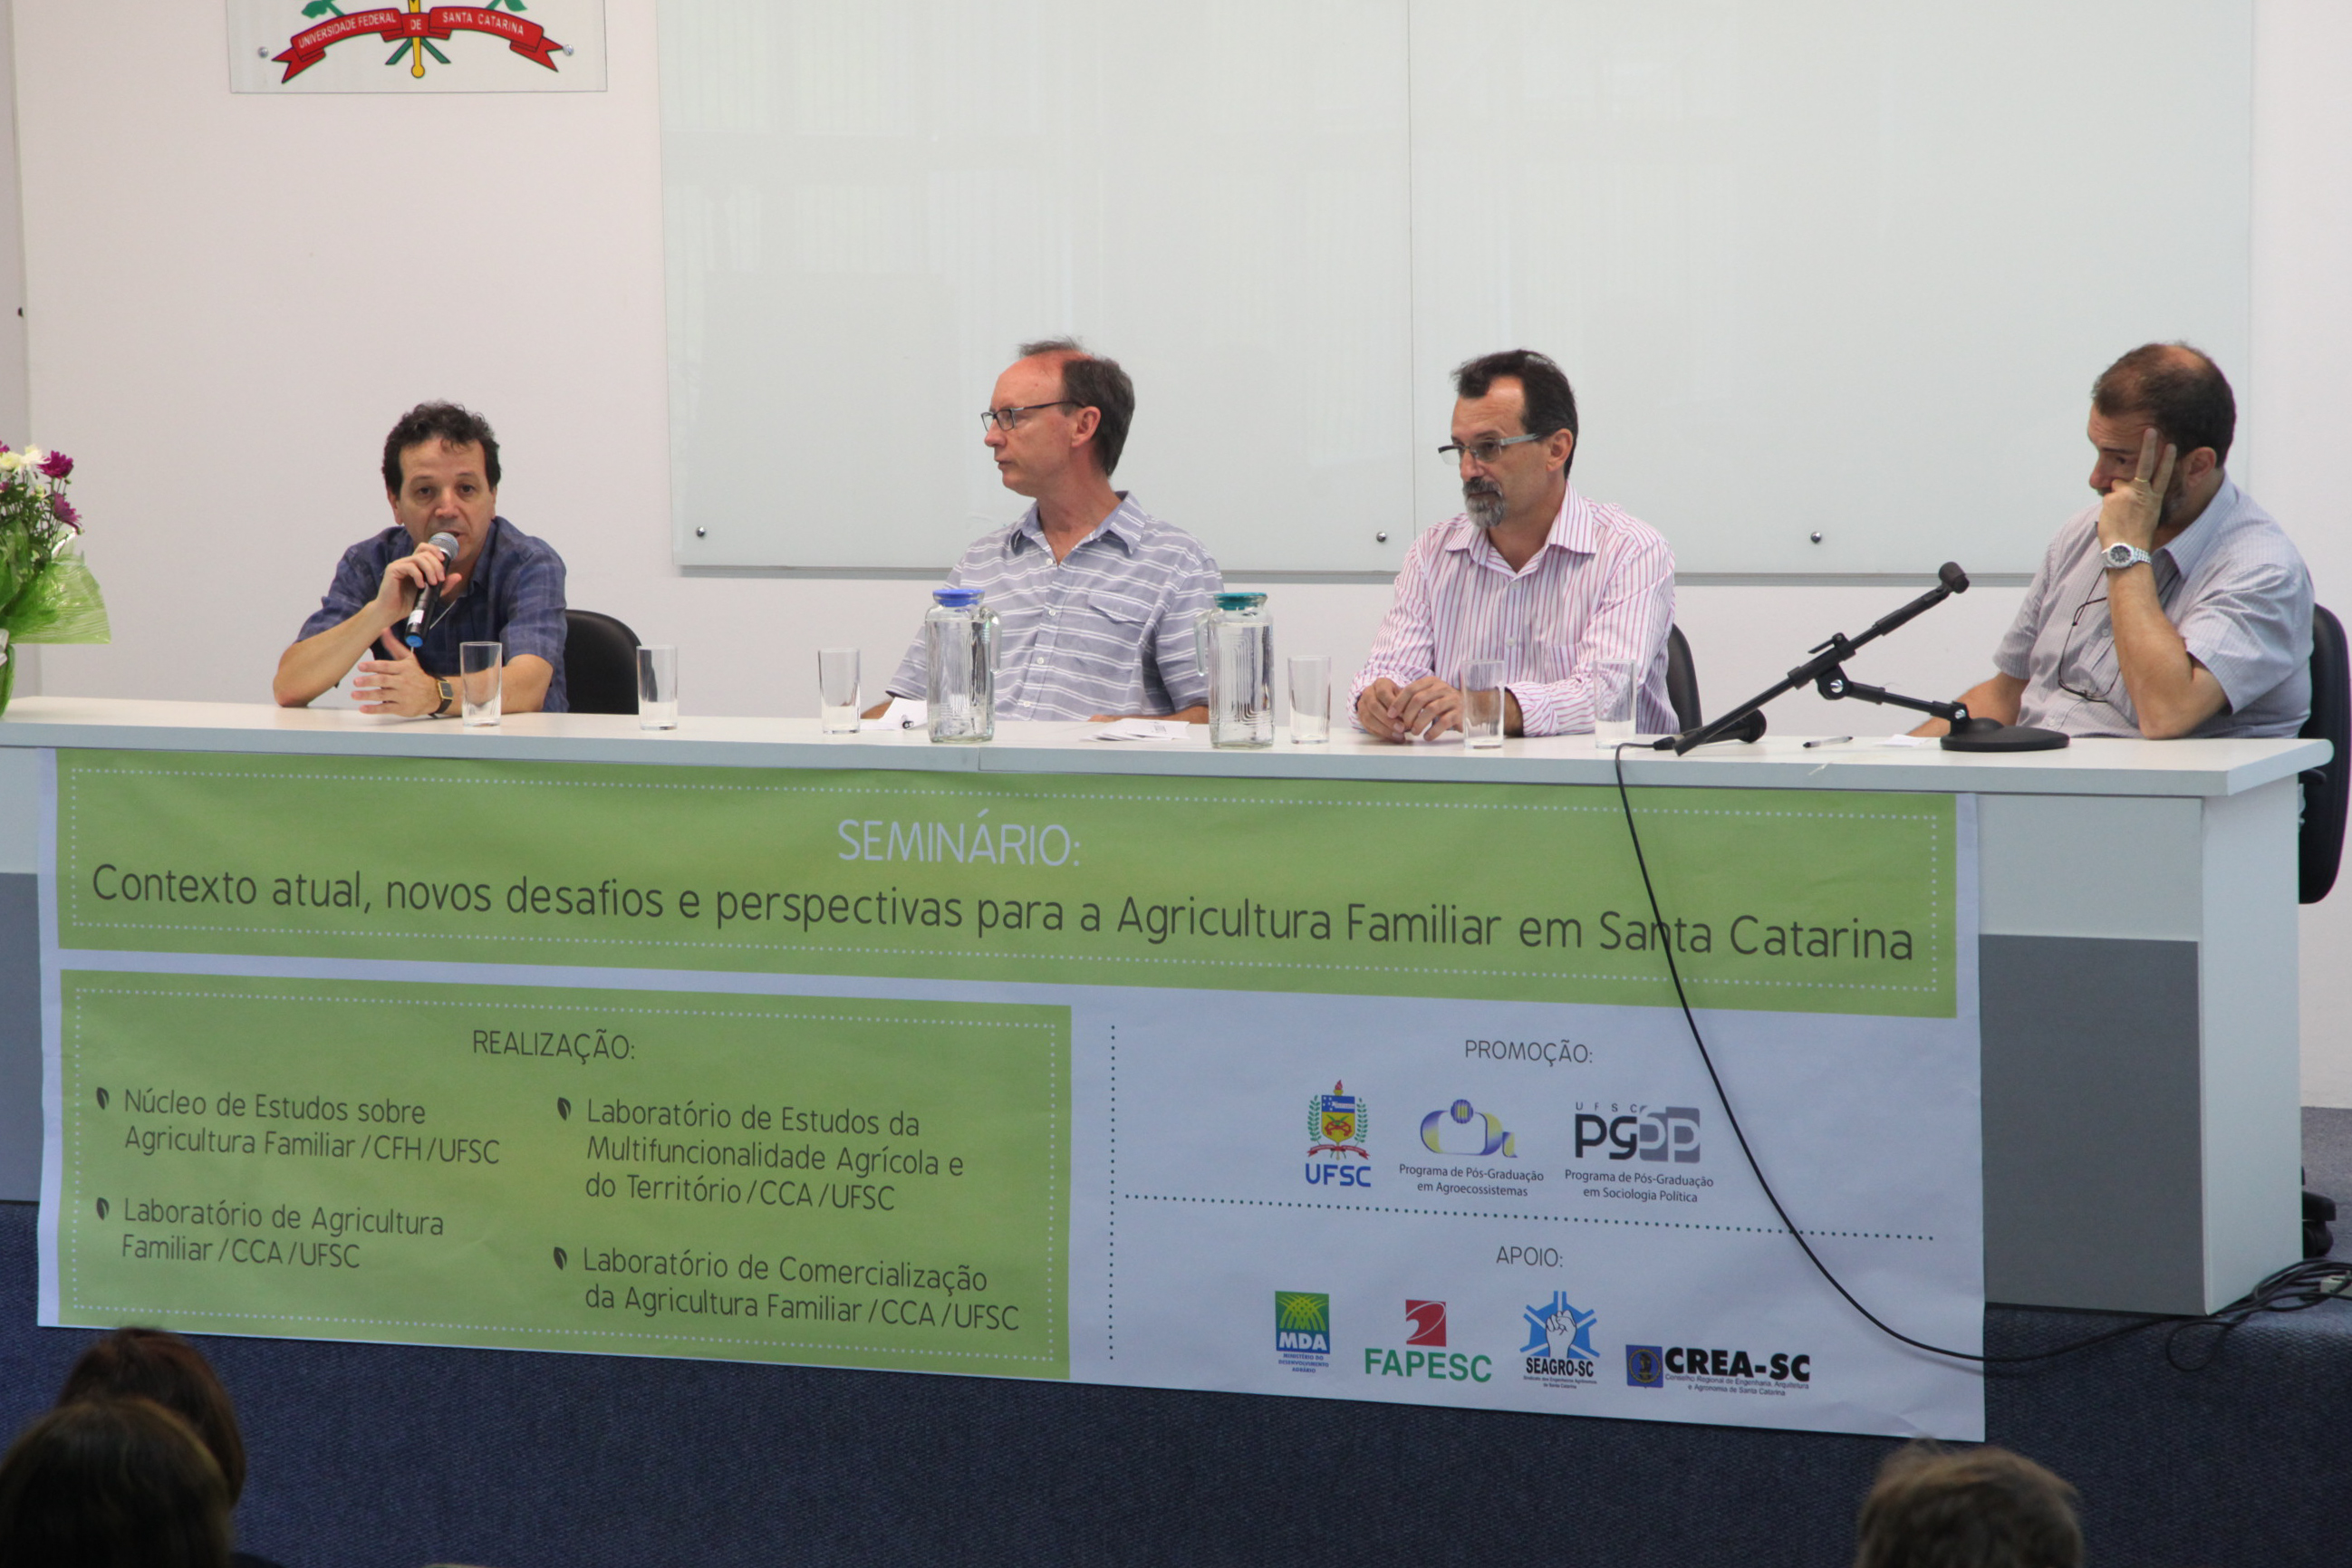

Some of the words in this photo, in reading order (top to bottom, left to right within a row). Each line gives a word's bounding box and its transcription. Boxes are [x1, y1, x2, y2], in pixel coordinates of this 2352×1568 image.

[299, 17, 357, 49] UNIVERSIDADE
[358, 13, 397, 27] FEDERAL
[410, 19, 421, 30] DE
[443, 12, 473, 24] SANTA
[477, 15, 524, 36] CATARINA
[837, 808, 1081, 866] SEMINÁRIO:
[92, 863, 257, 905] Contexto
[272, 870, 371, 914] atual,
[387, 880, 492, 912] novos
[506, 875, 664, 918] desafios
[679, 890, 700, 919] e
[717, 886, 963, 933] perspectivas
[978, 899, 1064, 938] para
[1080, 902, 1101, 932] a
[1117, 896, 1331, 945] Agricultura
[1347, 903, 1502, 946] Familiar
[1519, 917, 1582, 948] em
[1600, 910, 1711, 954] Santa
[1730, 914, 1913, 961] Catarina
[473, 1028, 635, 1065] REALIZAÇÃO:
[1465, 1038, 1593, 1068] PROMOÇÃO:
[124, 1087, 207, 1116] Núcleo
[217, 1092, 246, 1117] de
[255, 1093, 349, 1121] Estudos
[357, 1098, 426, 1125] sobre
[588, 1098, 731, 1129] Laboratório
[741, 1103, 772, 1130] de
[782, 1106, 880, 1135] Estudos
[889, 1110, 920, 1137] da
[124, 1125, 255, 1157] Agricultura
[587, 1135, 826, 1170] Multifuncionalidade
[836, 1145, 939, 1179] Agrícola
[949, 1157, 964, 1177] e
[585, 1171, 616, 1198] do
[1305, 1162, 1372, 1188] UFSC
[1399, 1163, 1449, 1178] Programa
[1450, 1166, 1464, 1178] de
[1466, 1167, 1545, 1184] Pós-Graduação
[1417, 1183, 1433, 1192] em
[1435, 1181, 1528, 1197] Agroecossistemas
[1565, 1169, 1616, 1184] Programa
[1617, 1171, 1632, 1183] de
[1634, 1172, 1714, 1189] Pós-Graduação
[1583, 1188, 1601, 1198] em
[1603, 1187, 1657, 1203] Sociologia
[1659, 1189, 1698, 1203] Política
[124, 1198, 263, 1228] Laboratório
[271, 1203, 301, 1229] de
[311, 1207, 444, 1238] Agricultura
[583, 1246, 728, 1278] Laboratório
[737, 1254, 769, 1281] de
[780, 1255, 988, 1297] Comercialização
[1496, 1246, 1563, 1268] APOIO:
[585, 1283, 615, 1309] da
[624, 1285, 758, 1318] Agricultura
[1279, 1332, 1327, 1351] MDA
[1364, 1347, 1492, 1383] FAPESC
[1526, 1357, 1594, 1377] SEAGRO-SC
[1665, 1347, 1810, 1382] CREA-SC
[1697, 1376, 1724, 1384] Regional
[1694, 1384, 1728, 1393] Agronomia
[1759, 1388, 1785, 1396] Catarina
